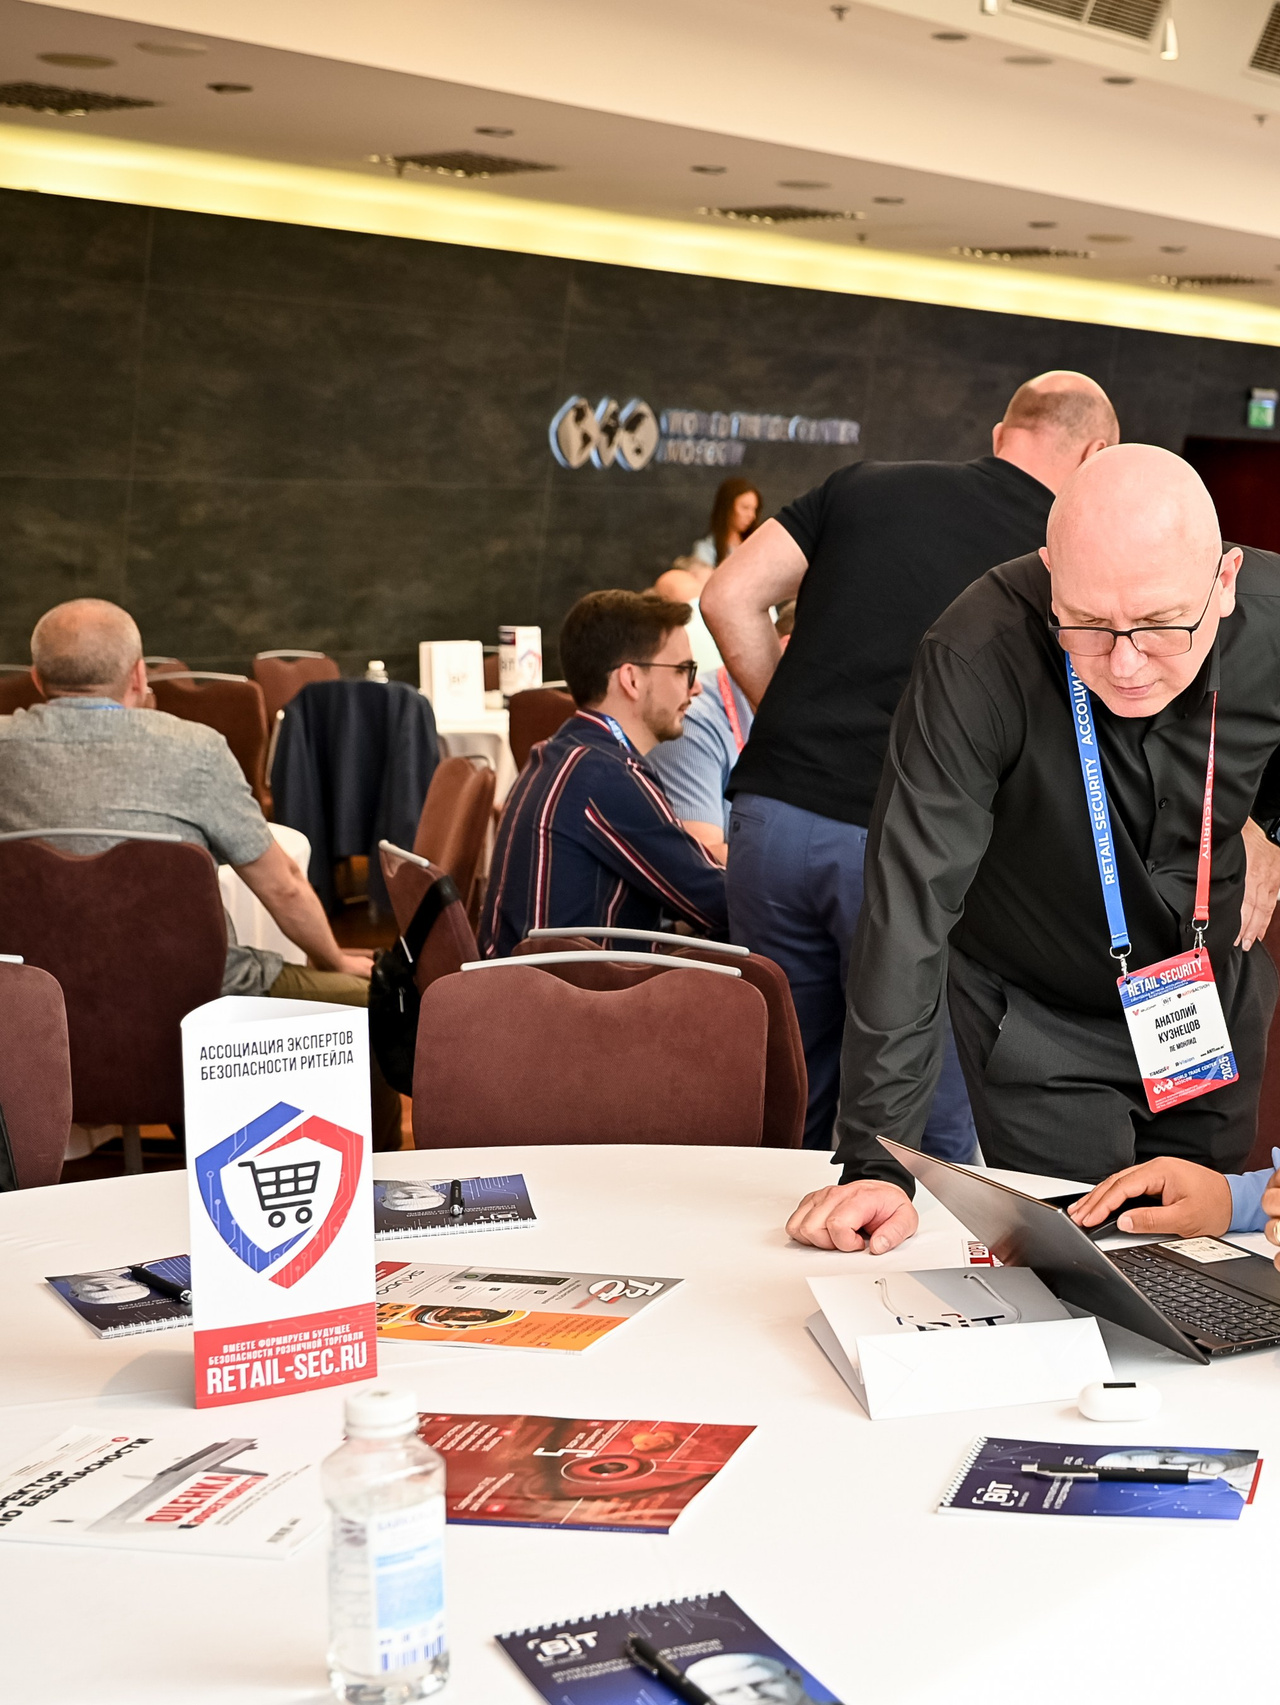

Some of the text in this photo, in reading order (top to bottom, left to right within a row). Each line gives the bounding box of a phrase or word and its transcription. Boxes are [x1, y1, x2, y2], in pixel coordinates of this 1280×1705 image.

[1070, 664, 1095, 746] АССОЦИ
[1084, 757, 1116, 886] RETAIL SECURITY
[1127, 976, 1160, 998] RETAIL
[1160, 959, 1203, 985] SECURITY
[1155, 1002, 1198, 1030] АНАТОЛИЙ
[1158, 1019, 1201, 1044] КУЗНЕЦОВ
[199, 1030, 354, 1061] АССОЦИАЦИЯ ЭКСПЕРТОВ
[201, 1050, 354, 1081] БЕЗОПАСНОСТИ РИТЕЙЛА
[1219, 1055, 1234, 1080] 2025
[208, 1331, 364, 1366] БЕЗОПАСНОСТИ РОЗНИЧНОЙ ТОРГОВЛИ
[222, 1323, 351, 1354] ВМЕСТЕ ФОРМИРУЕМ БУДУЩЕЕ
[206, 1341, 368, 1395] RETAIL-SEC.RU
[17, 1438, 154, 1507] БЕЗОПАСНОСТИ
[145, 1475, 241, 1522] ОЦЕНКА
